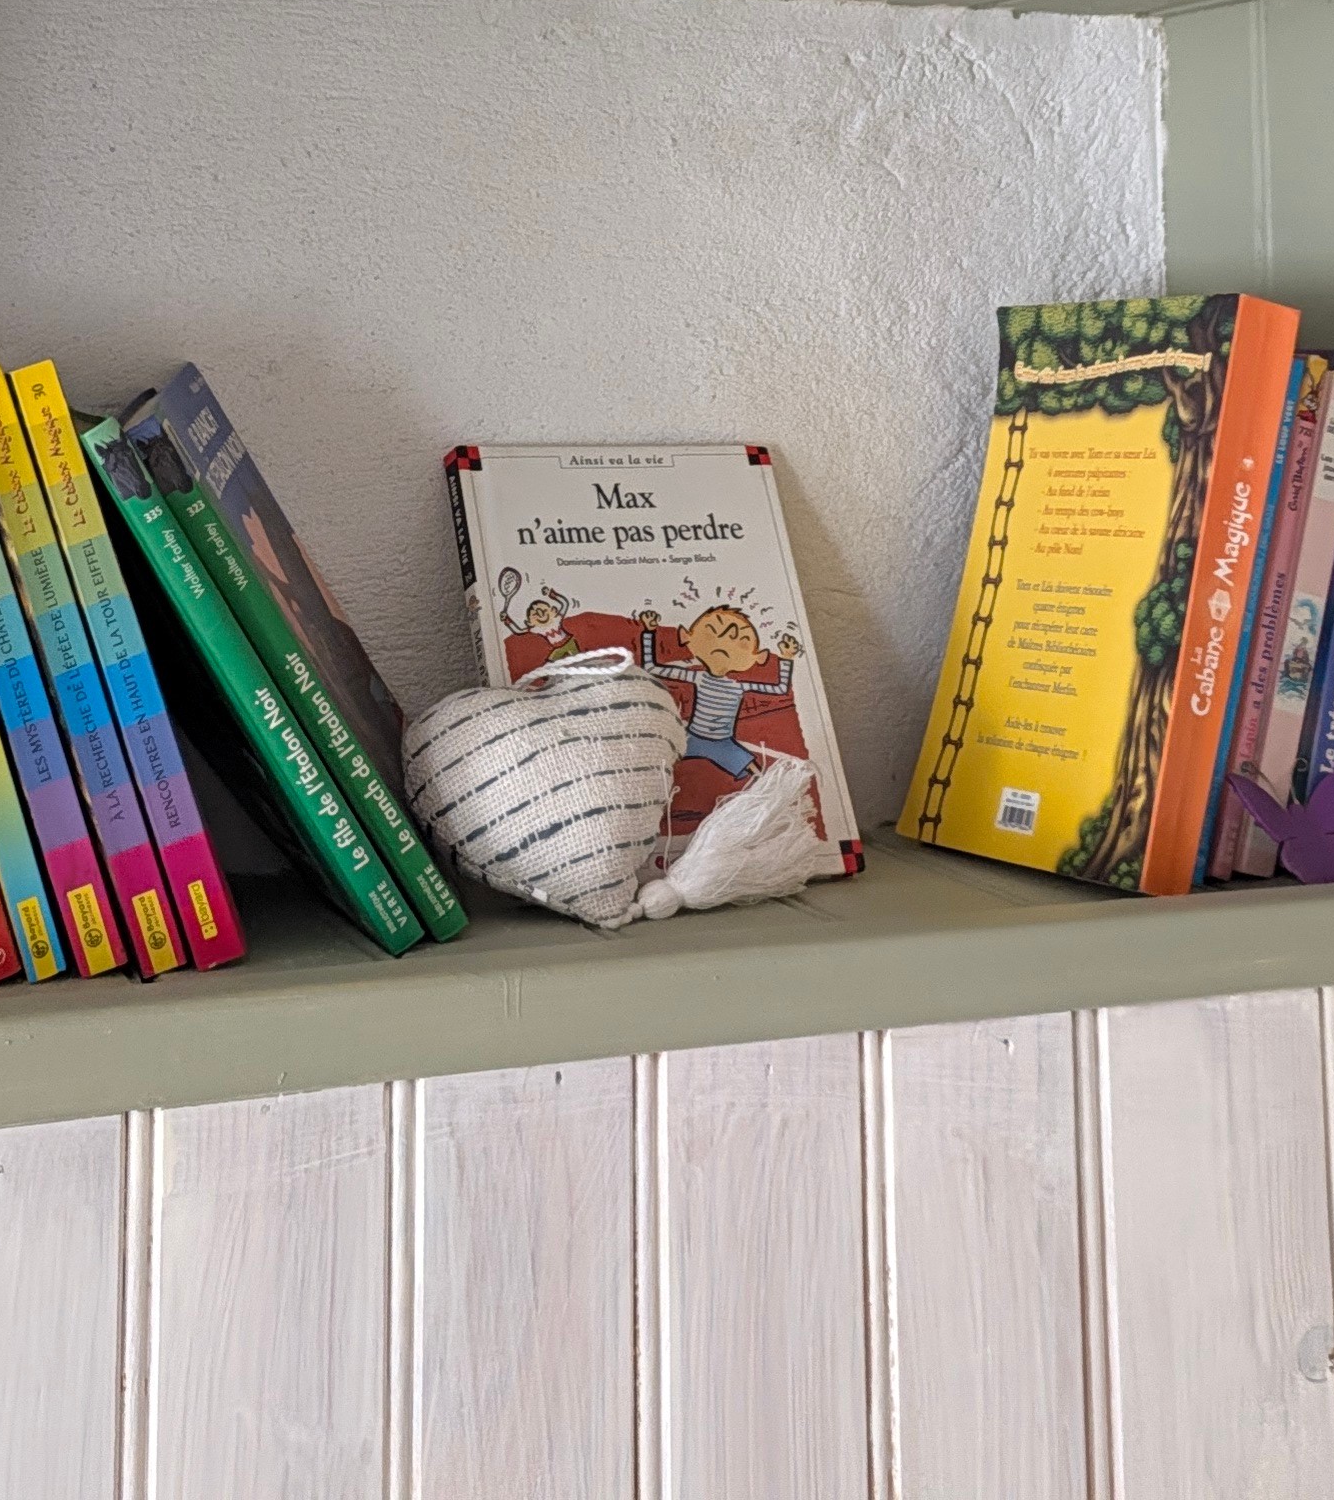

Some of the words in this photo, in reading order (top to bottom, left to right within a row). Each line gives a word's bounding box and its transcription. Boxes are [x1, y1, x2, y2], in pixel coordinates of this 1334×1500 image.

[569, 455, 604, 466] Ainsi
[609, 458, 624, 466] va
[629, 455, 641, 465] la
[645, 456, 665, 464] vie
[186, 500, 205, 518] 323
[592, 482, 657, 510] Max
[143, 506, 163, 524] 335
[517, 517, 606, 546] n'aime
[612, 524, 655, 550] pas
[661, 513, 745, 549] perdre
[556, 556, 601, 567] Dominique
[603, 556, 615, 566] de
[615, 556, 637, 566] Saint
[639, 556, 659, 565] Mars
[669, 554, 693, 566] Serge
[694, 553, 717, 563] Bloch
[1191, 626, 1225, 717] Cabane
[1213, 482, 1253, 586] Magique
[1262, 572, 1285, 662] problèmes
[285, 652, 316, 695] Noir
[1255, 662, 1267, 695] des
[255, 687, 285, 730] Noir
[1253, 700, 1261, 710] a
[311, 690, 355, 759] l'Étalon
[281, 727, 325, 796] l'Étalon
[351, 754, 371, 779] de
[318, 792, 339, 816] de
[364, 778, 402, 829] ranch
[332, 817, 357, 848] fils
[399, 828, 416, 854] Le
[352, 845, 369, 871] Le
[424, 864, 455, 910] VERTE
[377, 880, 407, 928] VERTE
